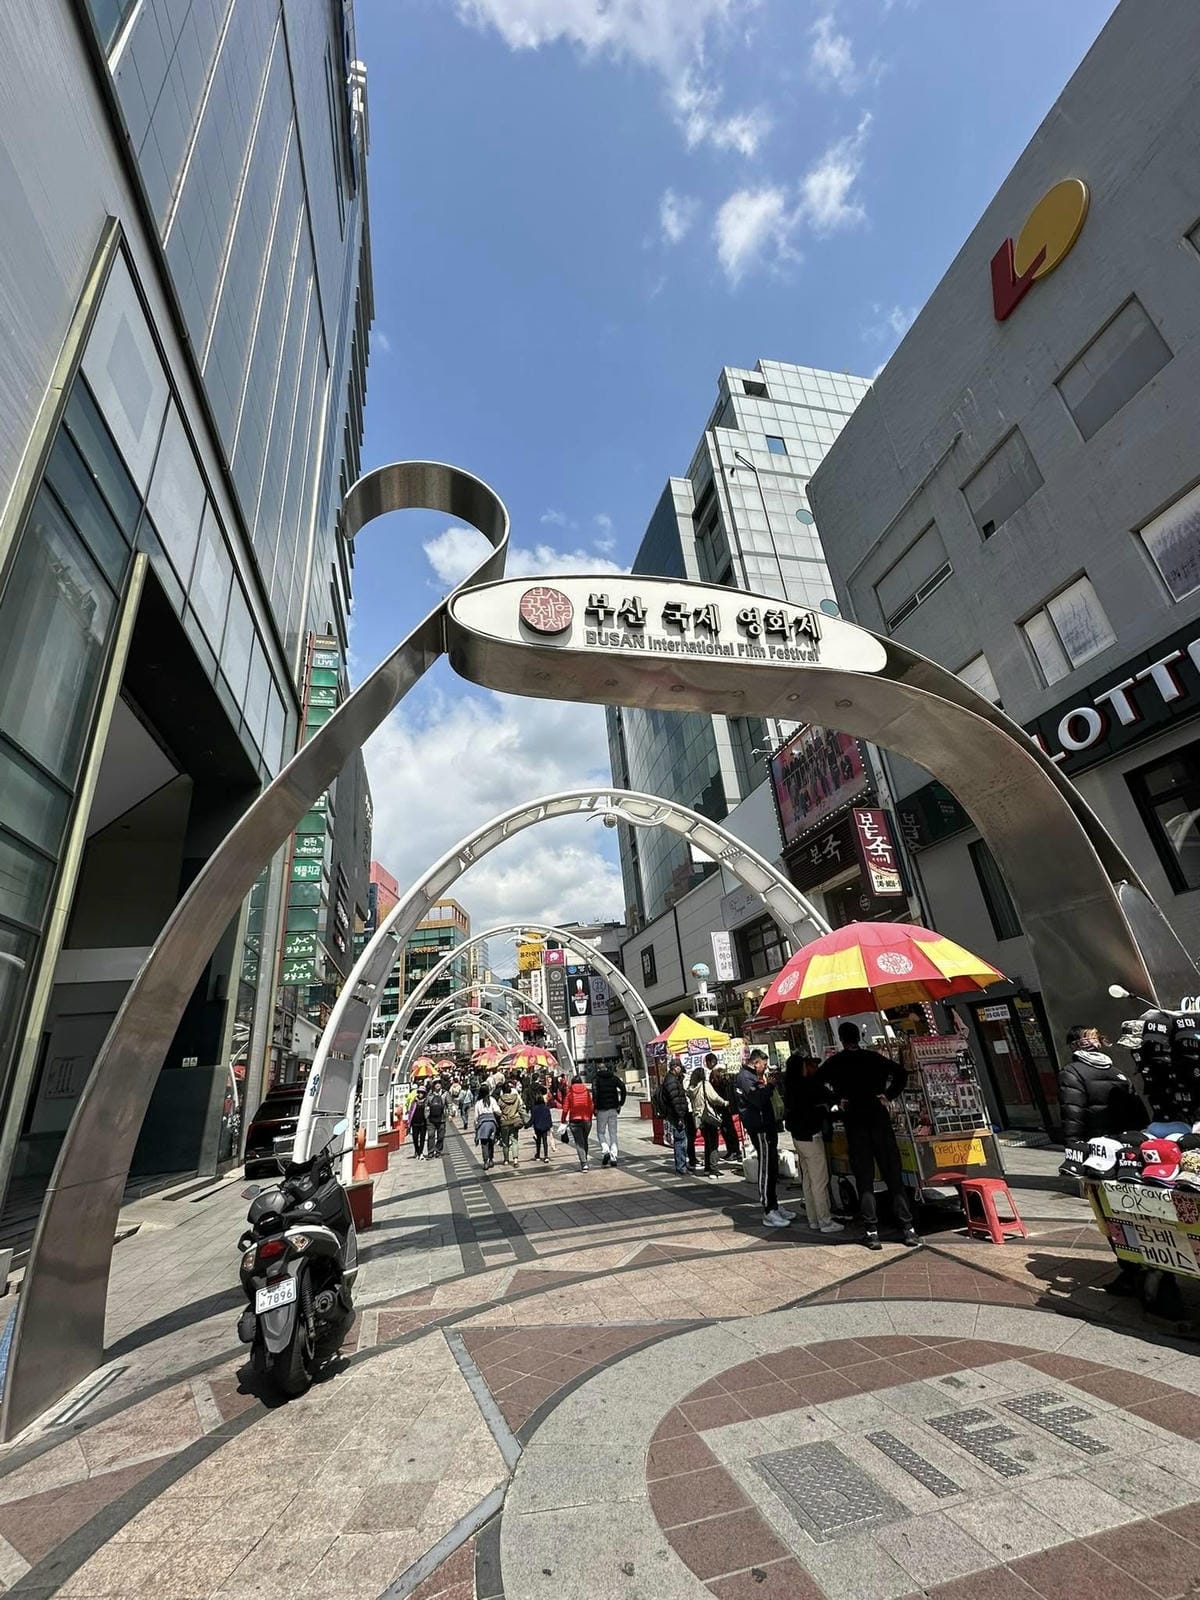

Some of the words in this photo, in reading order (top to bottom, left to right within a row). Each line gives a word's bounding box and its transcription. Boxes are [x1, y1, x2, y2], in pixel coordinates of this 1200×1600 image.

[584, 593, 649, 629] 부산
[661, 600, 721, 637] 국제
[736, 606, 822, 643] 영화제
[585, 630, 645, 649] BUSAN
[647, 635, 735, 656] International
[737, 642, 766, 658] Film
[768, 645, 819, 662] Festival
[858, 812, 893, 864] 본죽
[809, 833, 842, 865] 본죽
[1147, 1022, 1168, 1034] 아빠
[1176, 1018, 1196, 1029] 엄마
[952, 1152, 967, 1164] OK
[1121, 1195, 1152, 1212] OK
[1141, 1188, 1171, 1203] card
